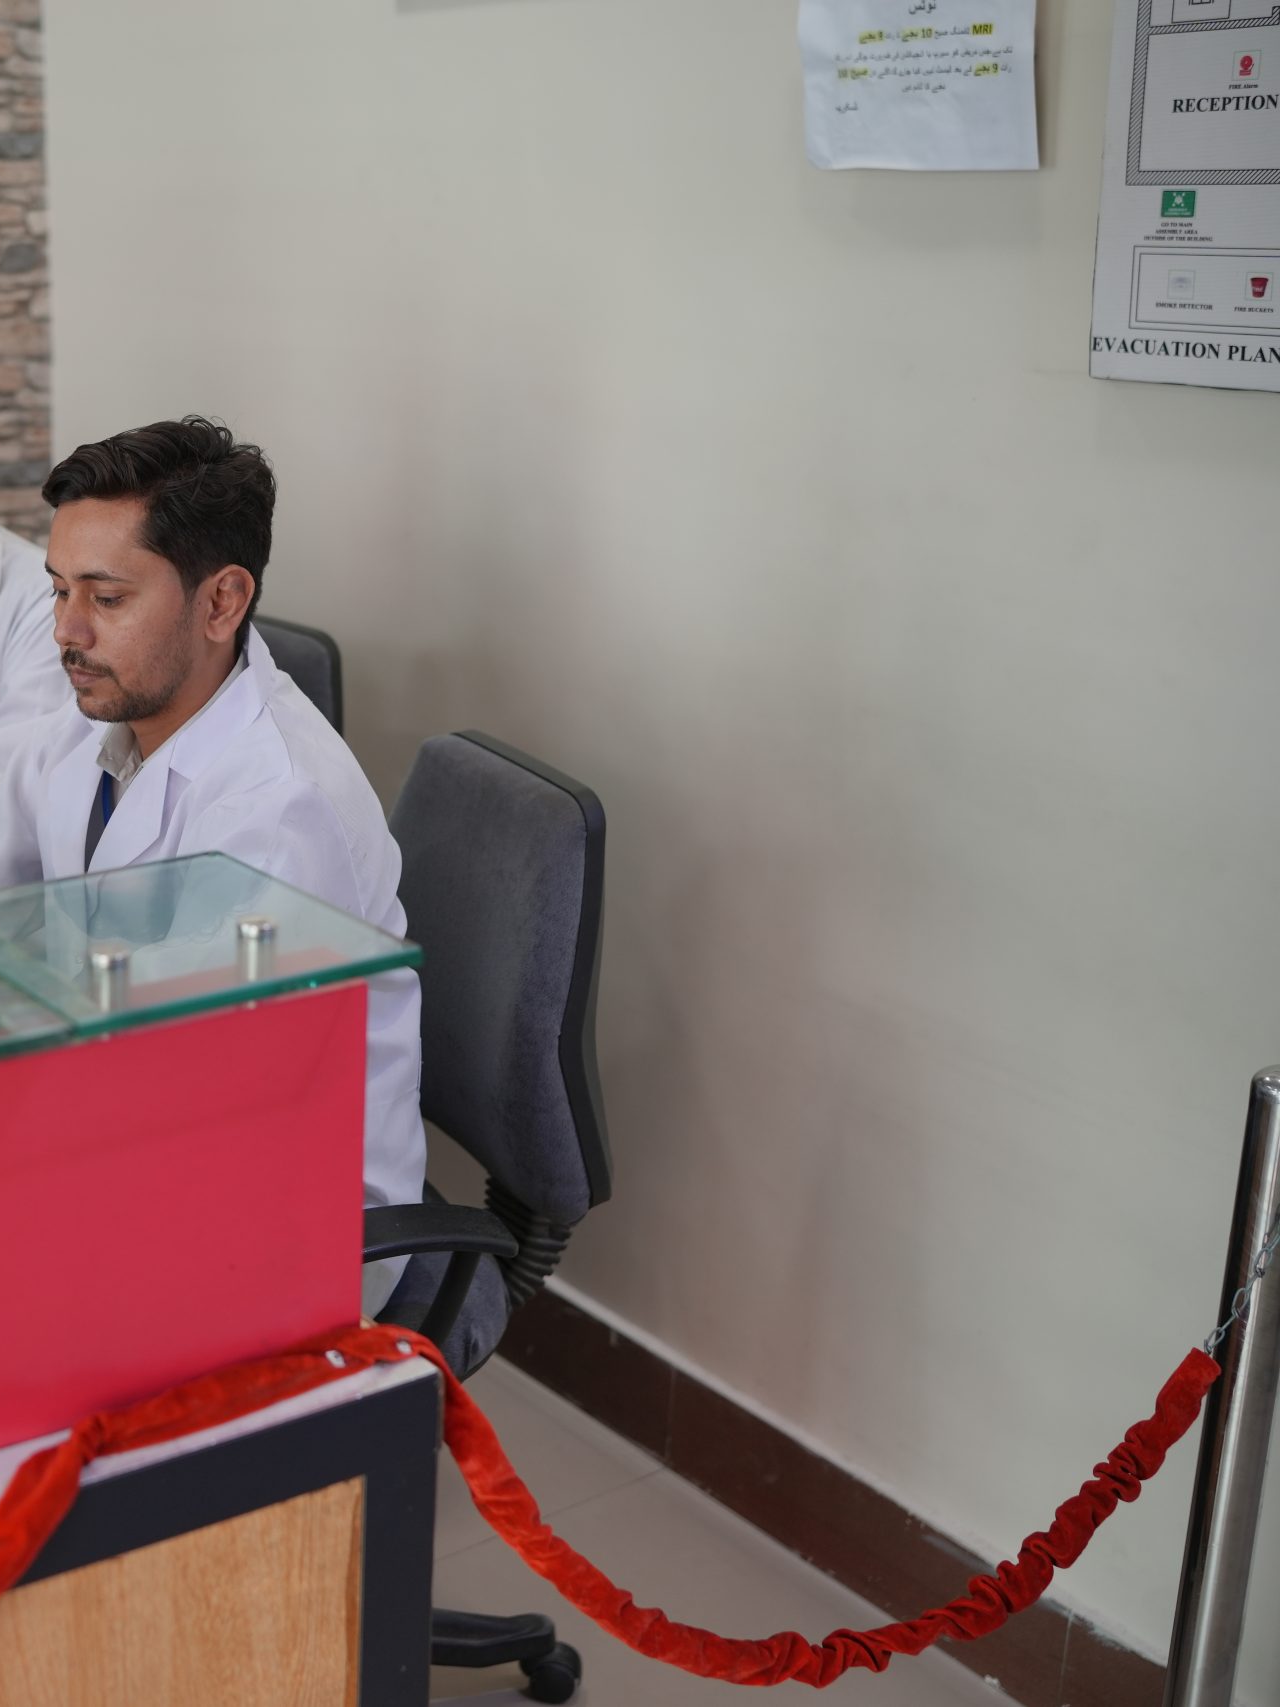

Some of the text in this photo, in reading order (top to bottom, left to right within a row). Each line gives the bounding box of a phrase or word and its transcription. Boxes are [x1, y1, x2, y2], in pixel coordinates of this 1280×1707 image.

[921, 28, 932, 38] 10
[972, 24, 993, 35] MRI
[992, 62, 998, 72] 9
[1172, 94, 1279, 113] RECEPTION
[1092, 337, 1280, 363] EVACUATION PLAN
